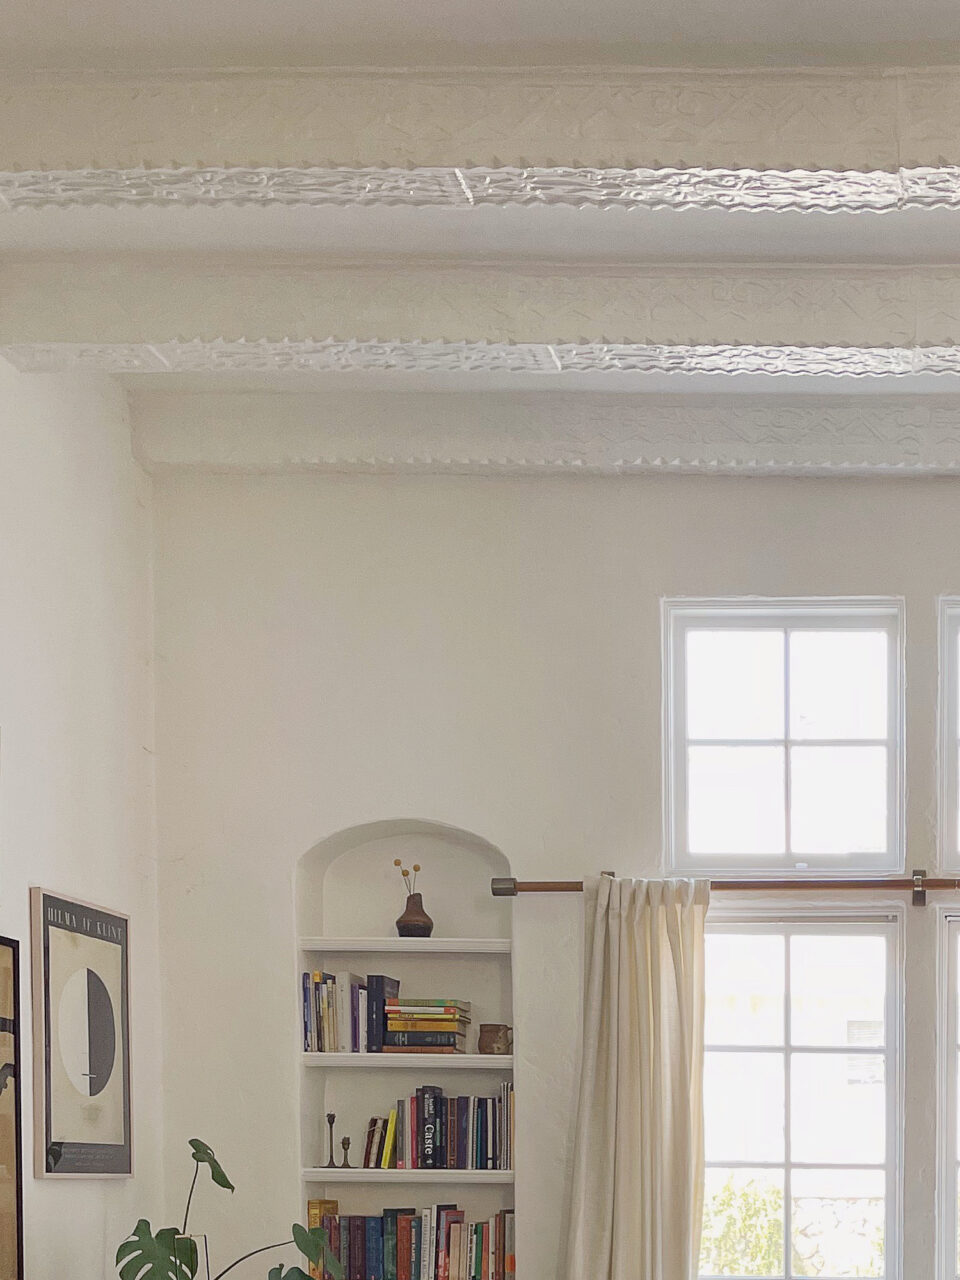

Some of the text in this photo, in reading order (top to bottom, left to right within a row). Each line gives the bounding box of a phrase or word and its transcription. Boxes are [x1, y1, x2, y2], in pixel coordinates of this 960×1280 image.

[47, 907, 122, 941] HILMA AF KLINT
[424, 1124, 435, 1155] Caste
